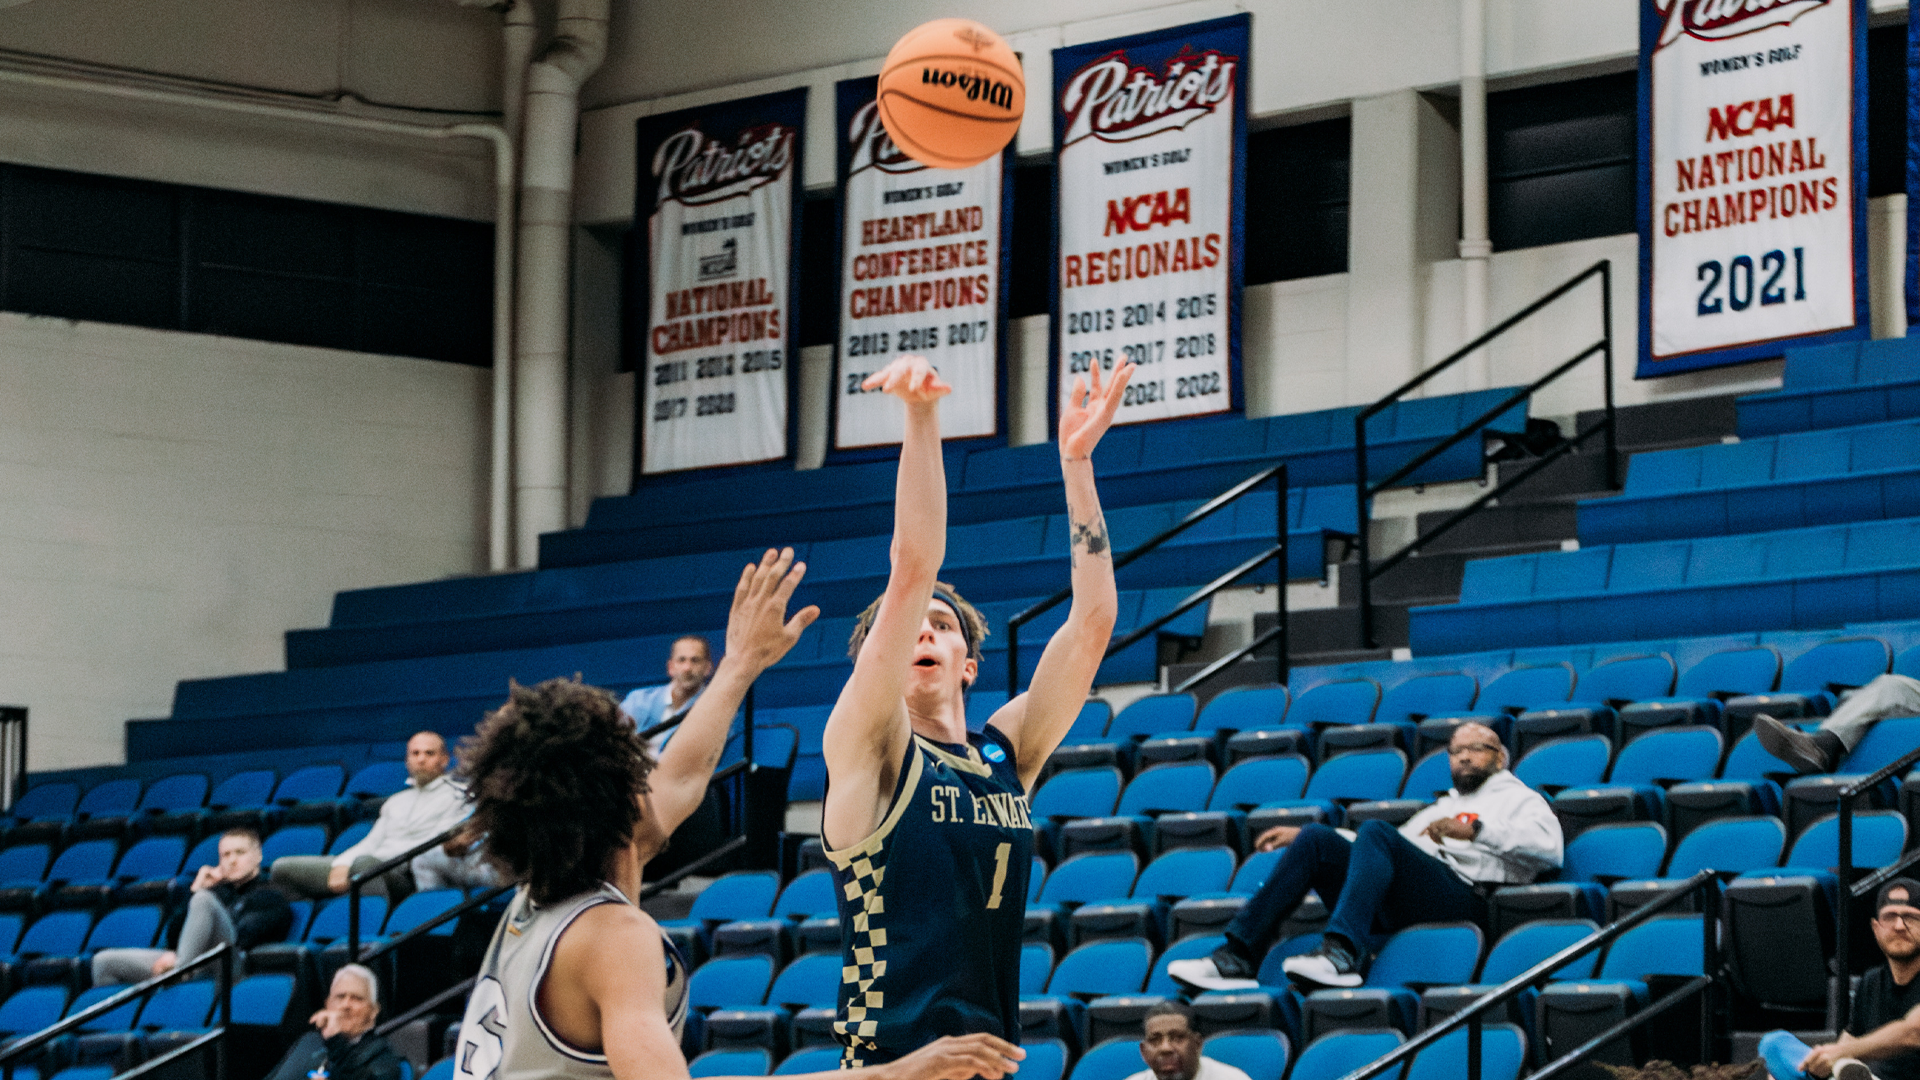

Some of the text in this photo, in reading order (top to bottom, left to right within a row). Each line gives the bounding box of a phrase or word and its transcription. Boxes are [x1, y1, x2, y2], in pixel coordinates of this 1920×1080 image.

[1768, 44, 1802, 65] GOLF
[921, 67, 1013, 111] Wilson
[1062, 54, 1237, 146] Patriots
[1706, 93, 1795, 143] NCAA
[1676, 137, 1826, 193] NATIONAL
[862, 206, 983, 246] HEARTLAND
[1103, 187, 1191, 237] NCAA
[1664, 177, 1839, 237] CHAMPIONS
[854, 240, 988, 281] CONFERENCE
[1065, 233, 1221, 289] REGIONALS
[1697, 247, 1806, 317] 2021
[666, 277, 774, 320] NATIONAL
[850, 274, 989, 319] CHAMPIONS
[1069, 294, 1217, 334] 2013 2014 2015
[652, 309, 780, 355] CHAMPIONS
[848, 332, 889, 357] 2013
[947, 321, 987, 346] 2017
[1123, 371, 1221, 407] 2021 2022
[931, 785, 964, 823] ST.
[986, 843, 1012, 909] 1
